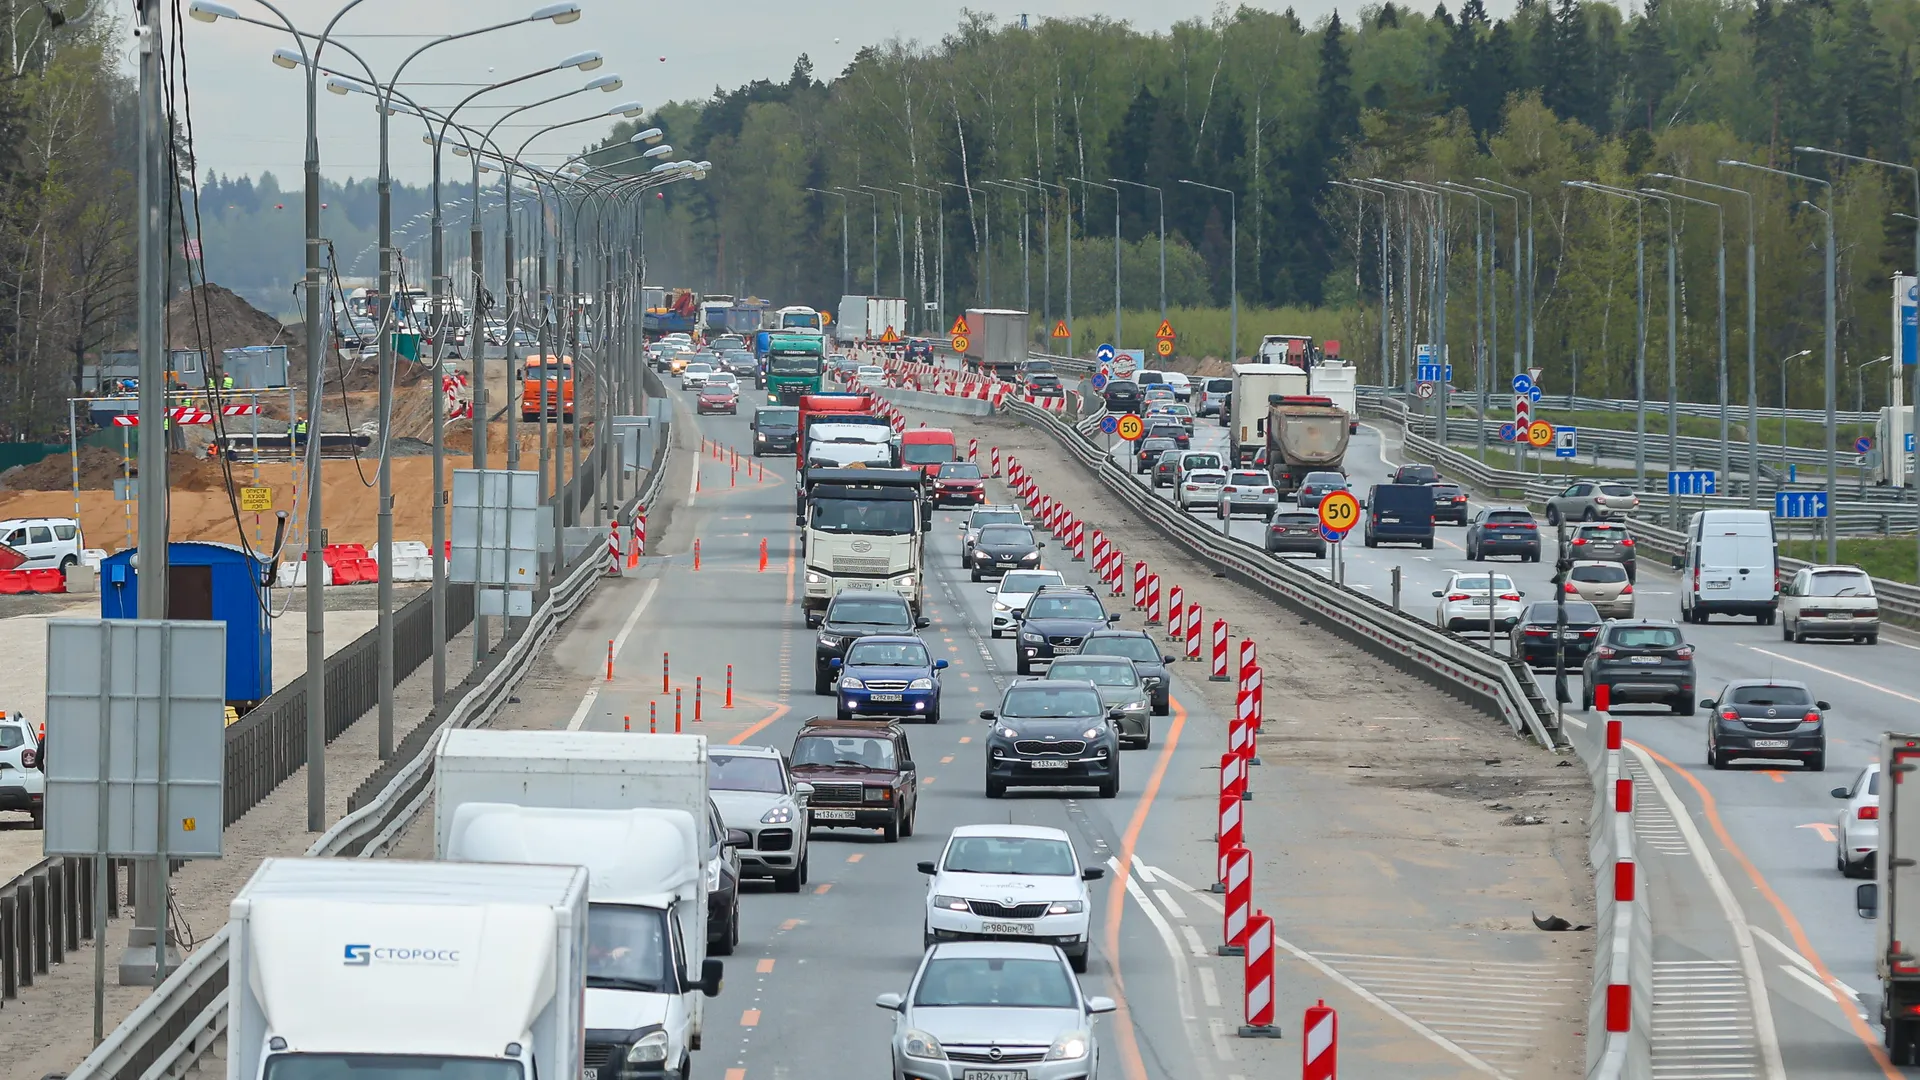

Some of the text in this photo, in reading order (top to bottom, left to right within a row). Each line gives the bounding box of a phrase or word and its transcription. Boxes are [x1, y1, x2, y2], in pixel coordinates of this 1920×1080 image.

[1123, 422, 1138, 432] 50
[1533, 429, 1547, 439] 50
[1329, 503, 1350, 519] 50
[374, 948, 460, 961] СТОРОСС
